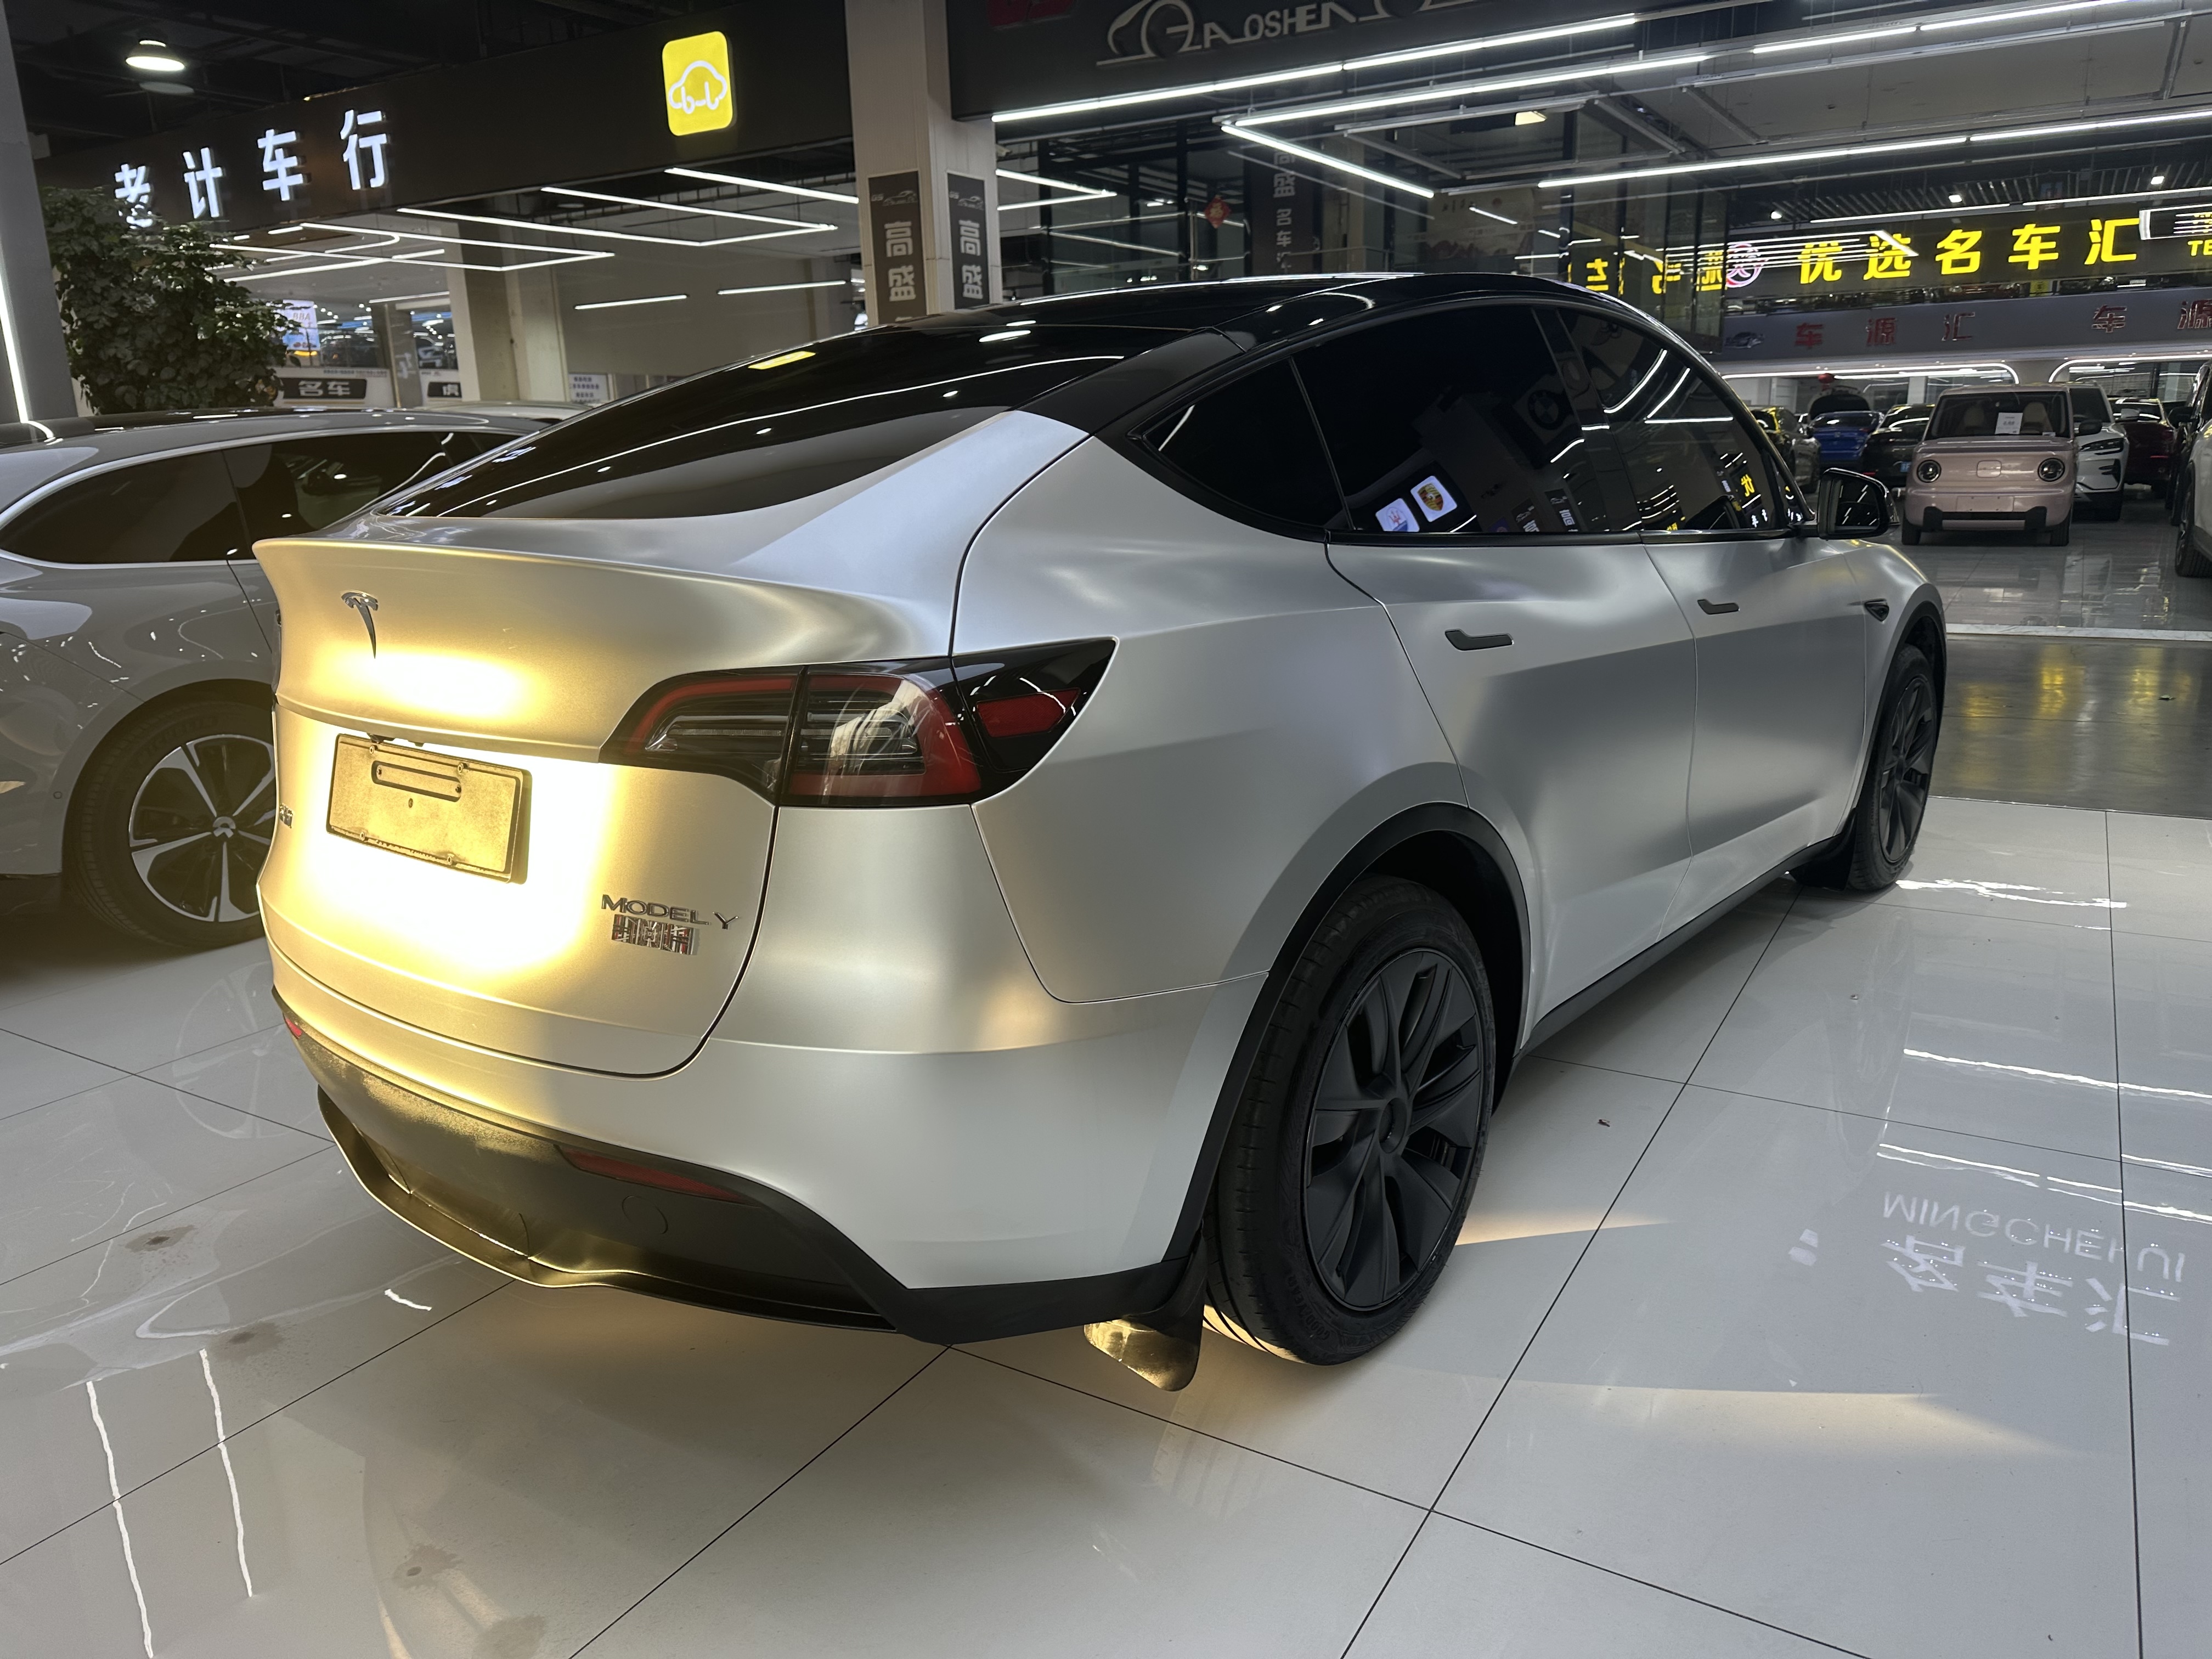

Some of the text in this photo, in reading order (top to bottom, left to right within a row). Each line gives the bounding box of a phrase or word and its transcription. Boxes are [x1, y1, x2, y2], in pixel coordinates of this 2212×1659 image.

[115, 109, 387, 229] 老计车行
[884, 221, 916, 321] 高盛
[1798, 218, 2140, 284] 优选名车汇
[1794, 312, 1975, 348] 车源汇
[601, 894, 740, 930] MODEL Y
